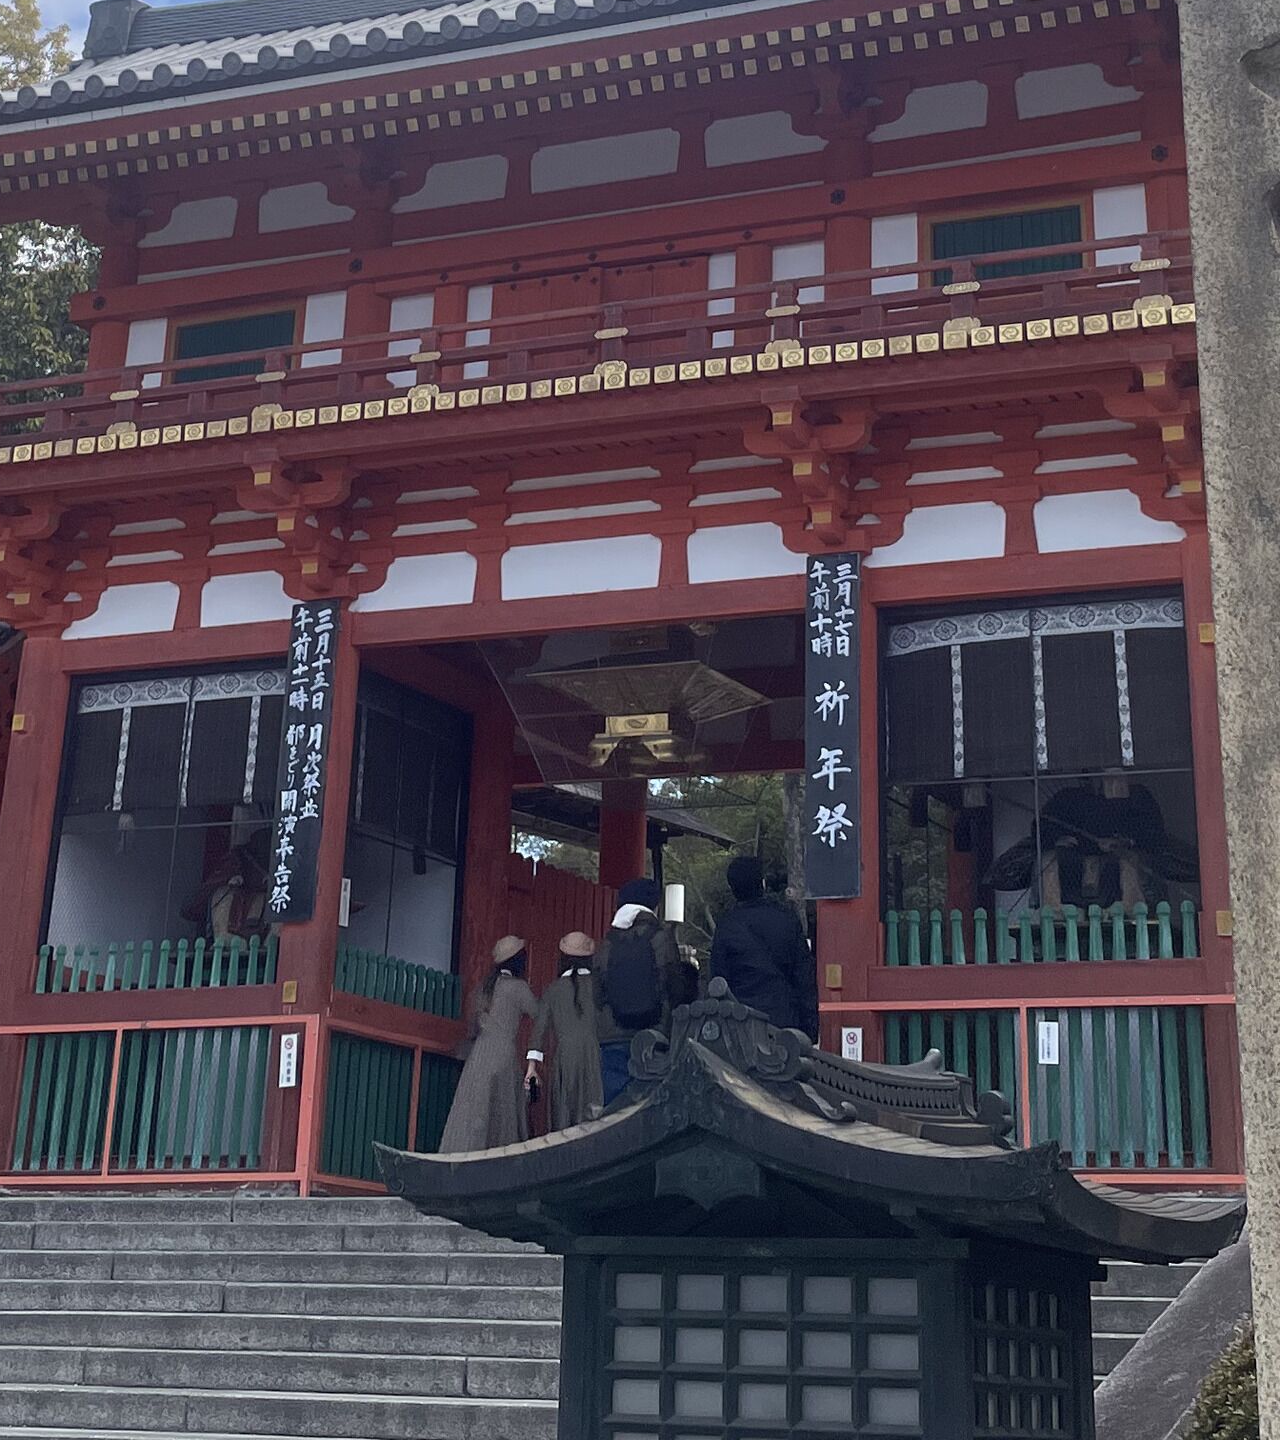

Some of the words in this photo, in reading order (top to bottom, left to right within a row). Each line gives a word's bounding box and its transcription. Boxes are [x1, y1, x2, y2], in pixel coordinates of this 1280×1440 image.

[288, 607, 314, 712] 午前十一時
[310, 608, 334, 711] 三月十五日
[809, 561, 833, 658] 午前十時
[832, 563, 858, 657] 三月十七日
[299, 723, 324, 820] 月次祭並
[811, 680, 854, 848] 祈年祭
